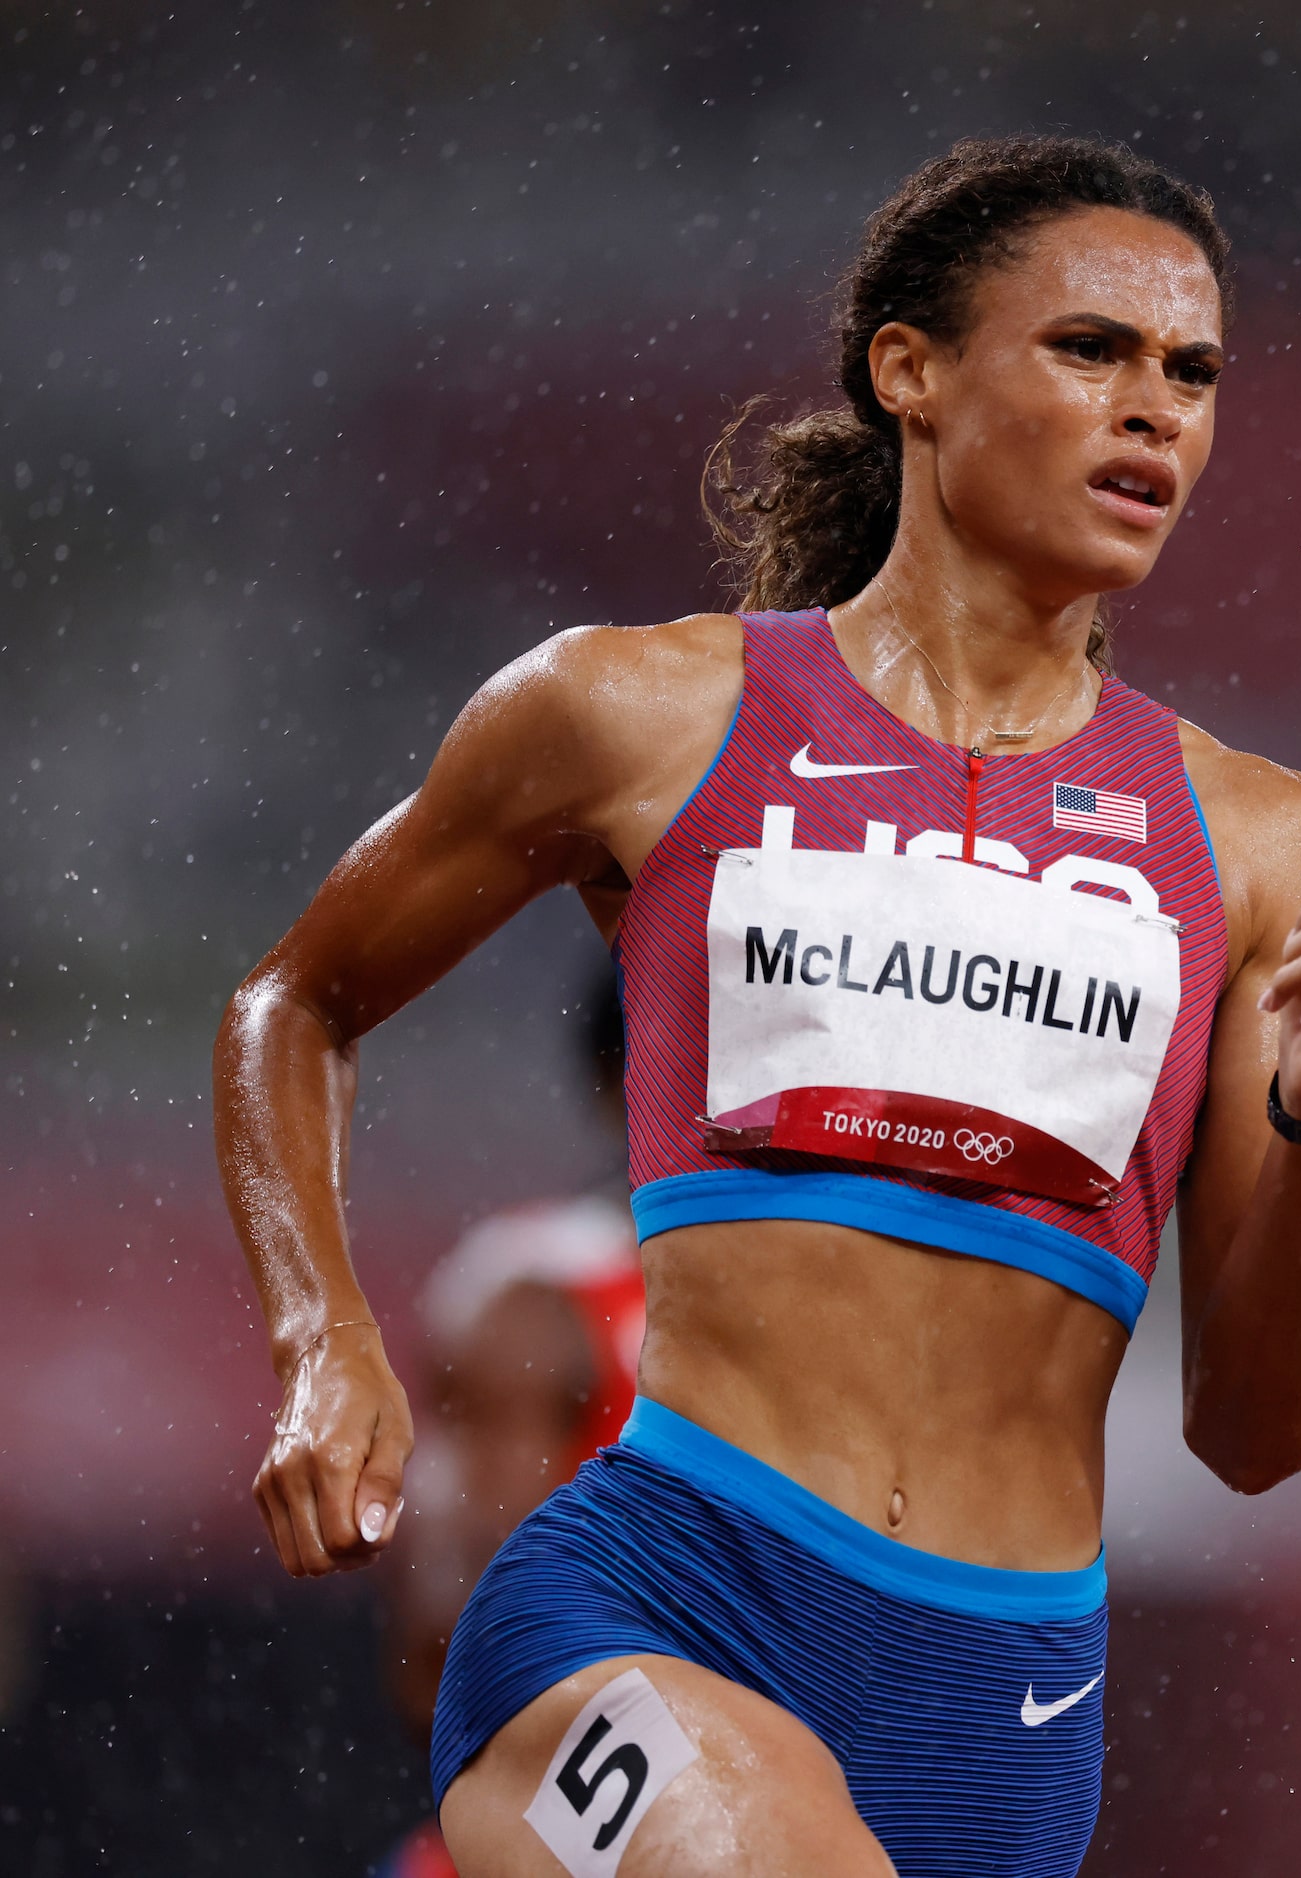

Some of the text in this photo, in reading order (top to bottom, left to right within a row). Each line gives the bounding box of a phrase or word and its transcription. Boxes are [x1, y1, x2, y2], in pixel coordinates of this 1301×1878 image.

[745, 926, 1142, 1043] McLAUGHLIN
[822, 1111, 946, 1150] TOKYO 2020
[555, 1713, 649, 1851] 5
